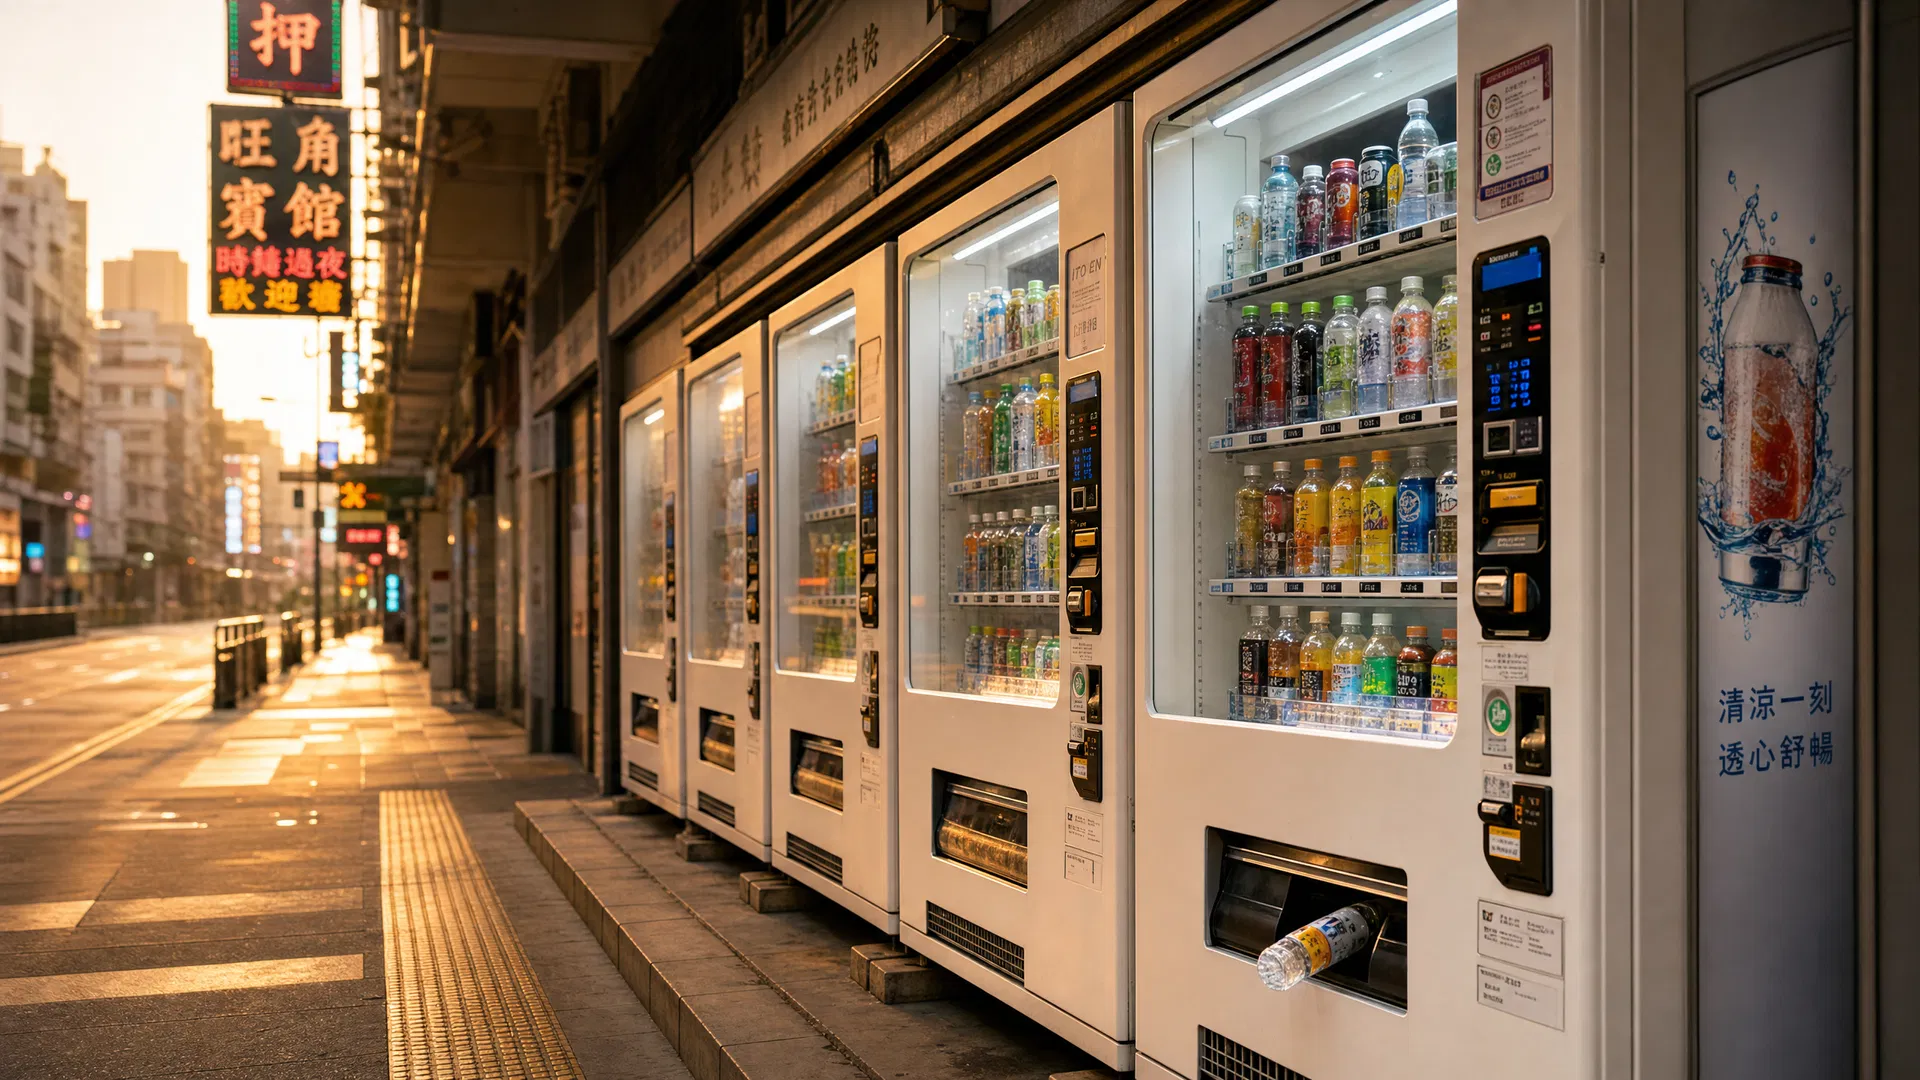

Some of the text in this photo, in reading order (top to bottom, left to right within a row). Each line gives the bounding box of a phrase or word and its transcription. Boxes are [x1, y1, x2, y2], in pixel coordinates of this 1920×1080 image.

[249, 1, 322, 77] 押
[218, 114, 341, 177] 旺角
[218, 176, 346, 243] 賓館
[1071, 257, 1103, 280] ITO EN
[1719, 680, 1833, 724] 清涼一刻
[1719, 731, 1834, 777] 透心舒暢
